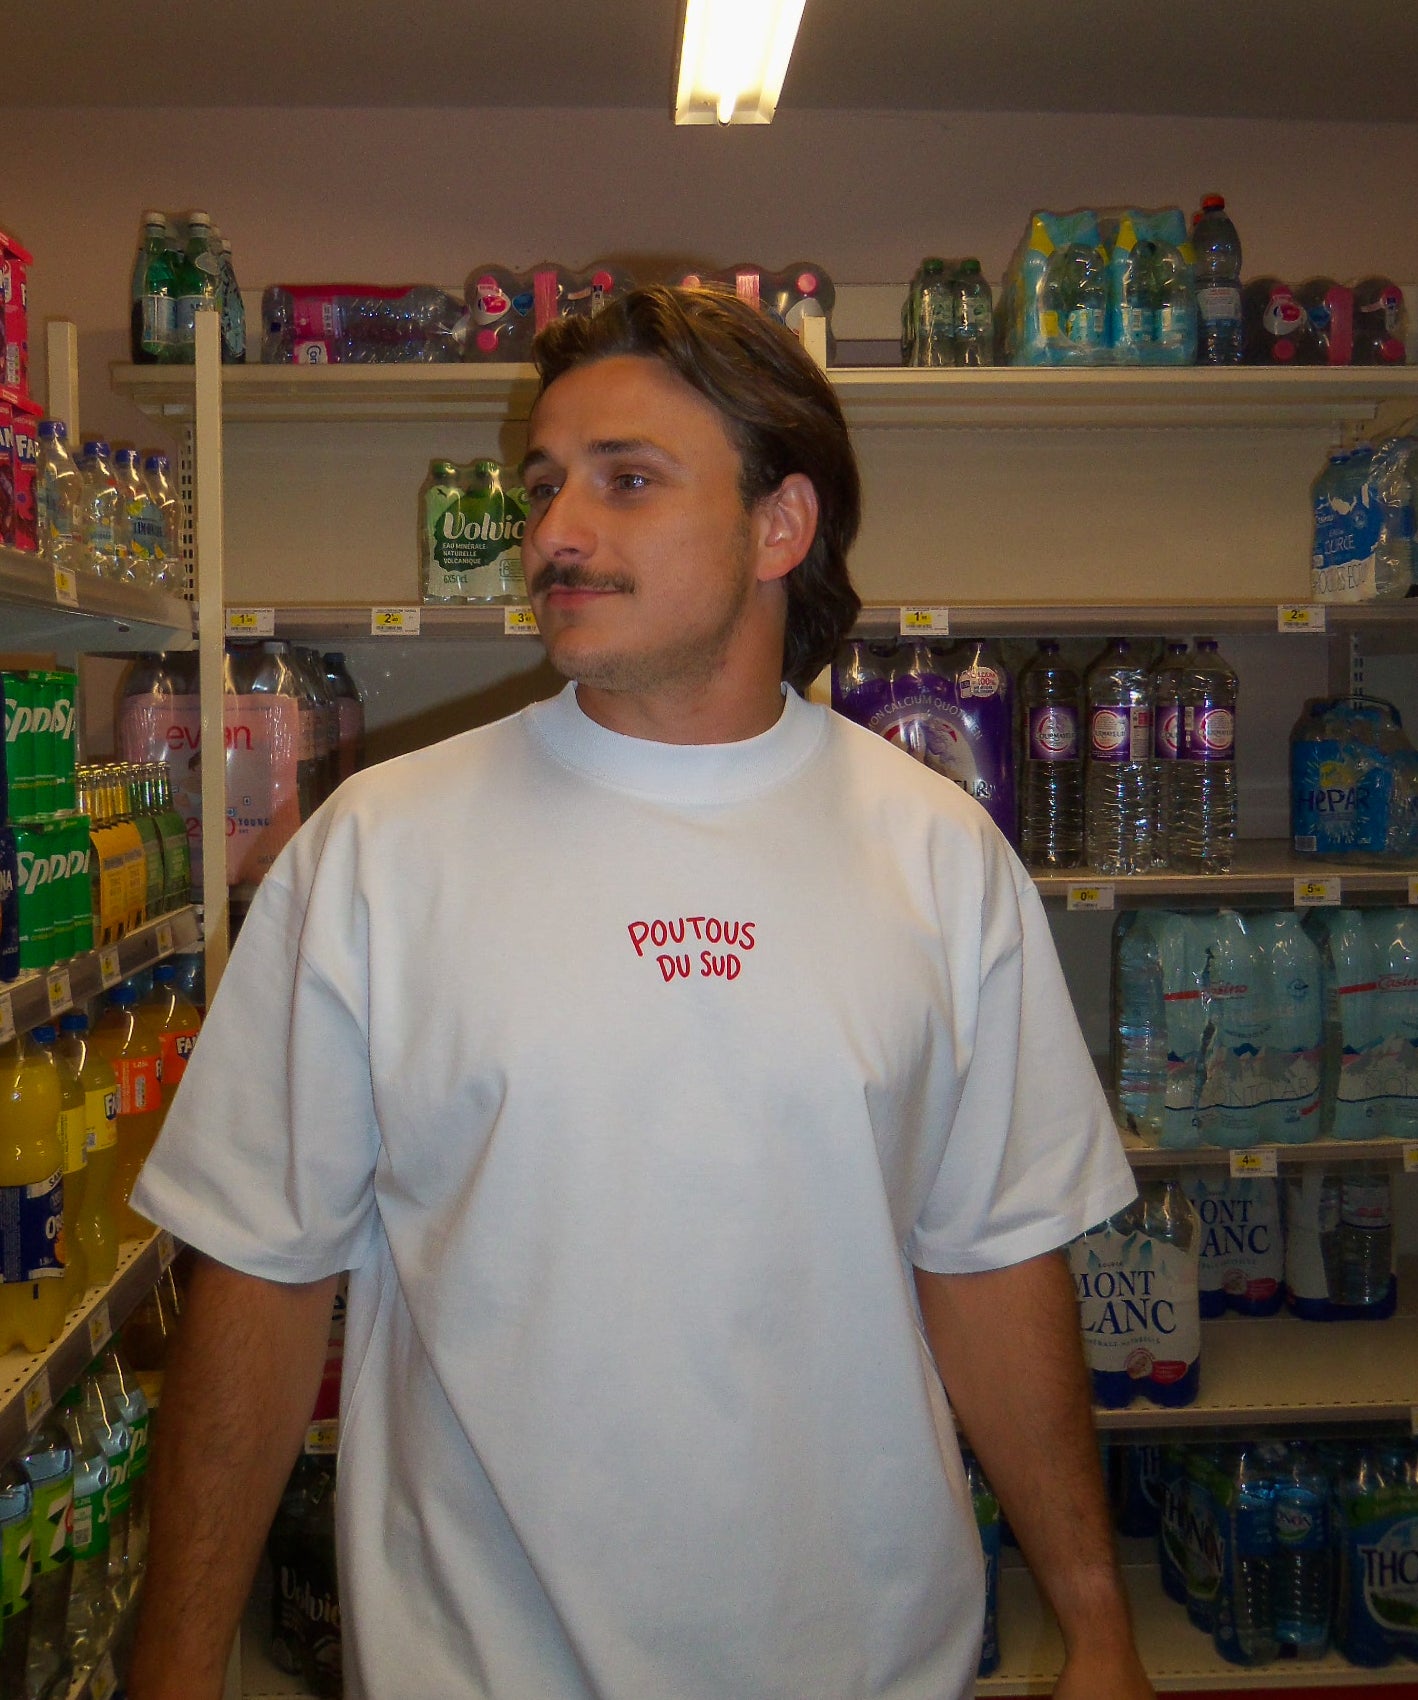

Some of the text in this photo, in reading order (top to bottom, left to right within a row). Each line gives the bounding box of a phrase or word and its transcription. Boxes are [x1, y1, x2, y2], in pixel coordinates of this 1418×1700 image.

[443, 511, 526, 541] Volvic
[884, 695, 932, 714] CALCIUM
[628, 916, 756, 957] POUTOUS
[656, 950, 742, 983] DU SUD
